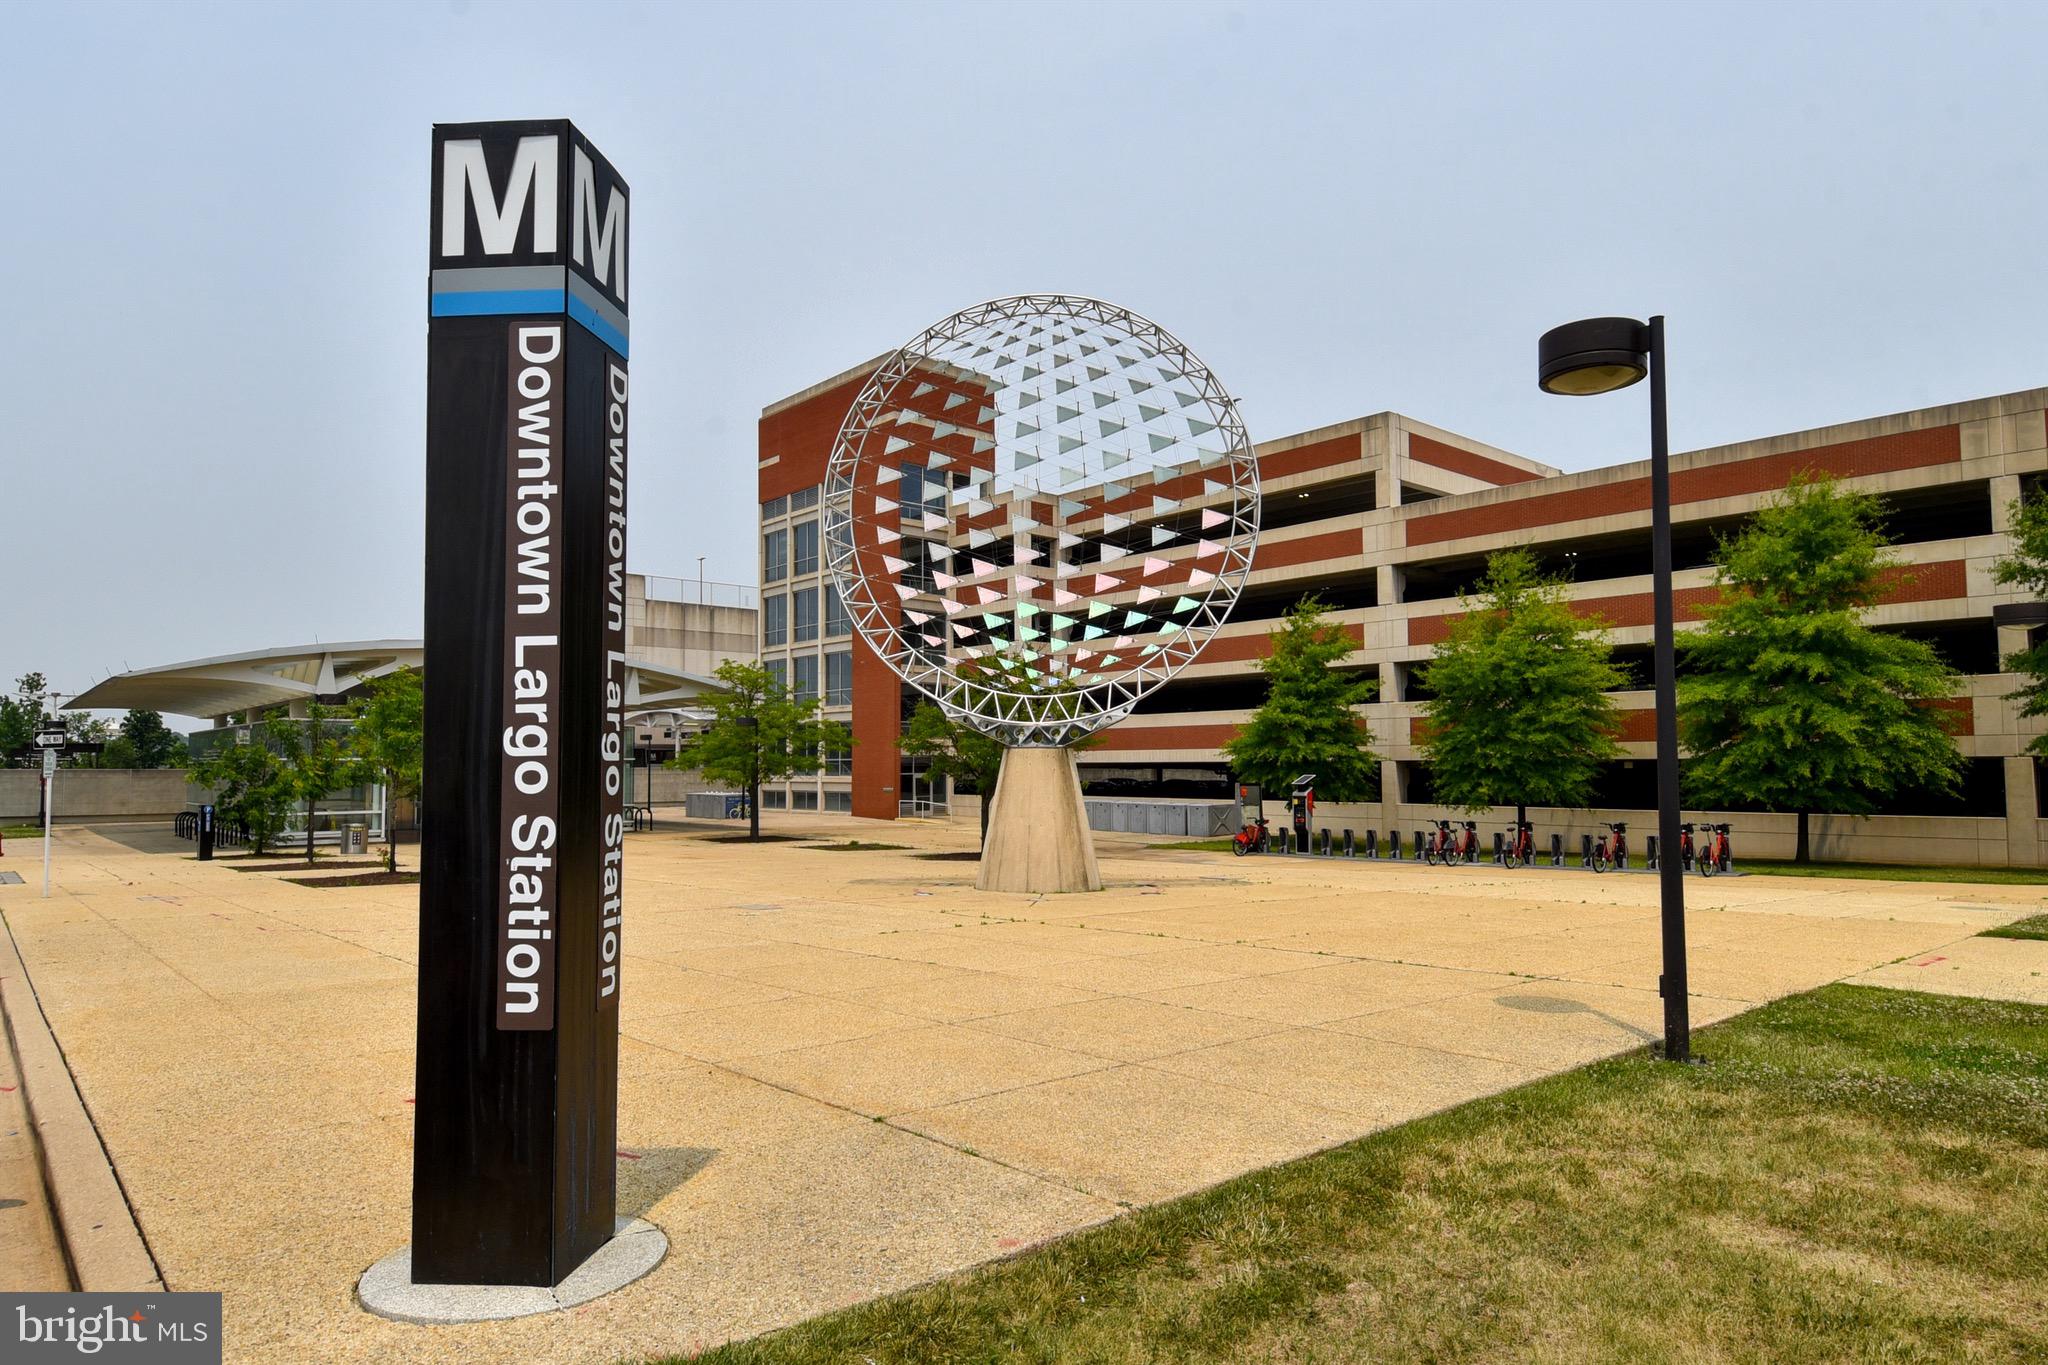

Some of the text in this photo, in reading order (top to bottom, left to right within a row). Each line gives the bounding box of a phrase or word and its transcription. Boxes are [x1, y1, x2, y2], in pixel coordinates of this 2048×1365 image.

[442, 135, 558, 256] M
[573, 144, 625, 303] M
[503, 326, 561, 1013] Downtown Largo Station
[601, 363, 628, 997] Downtown Largo Station
